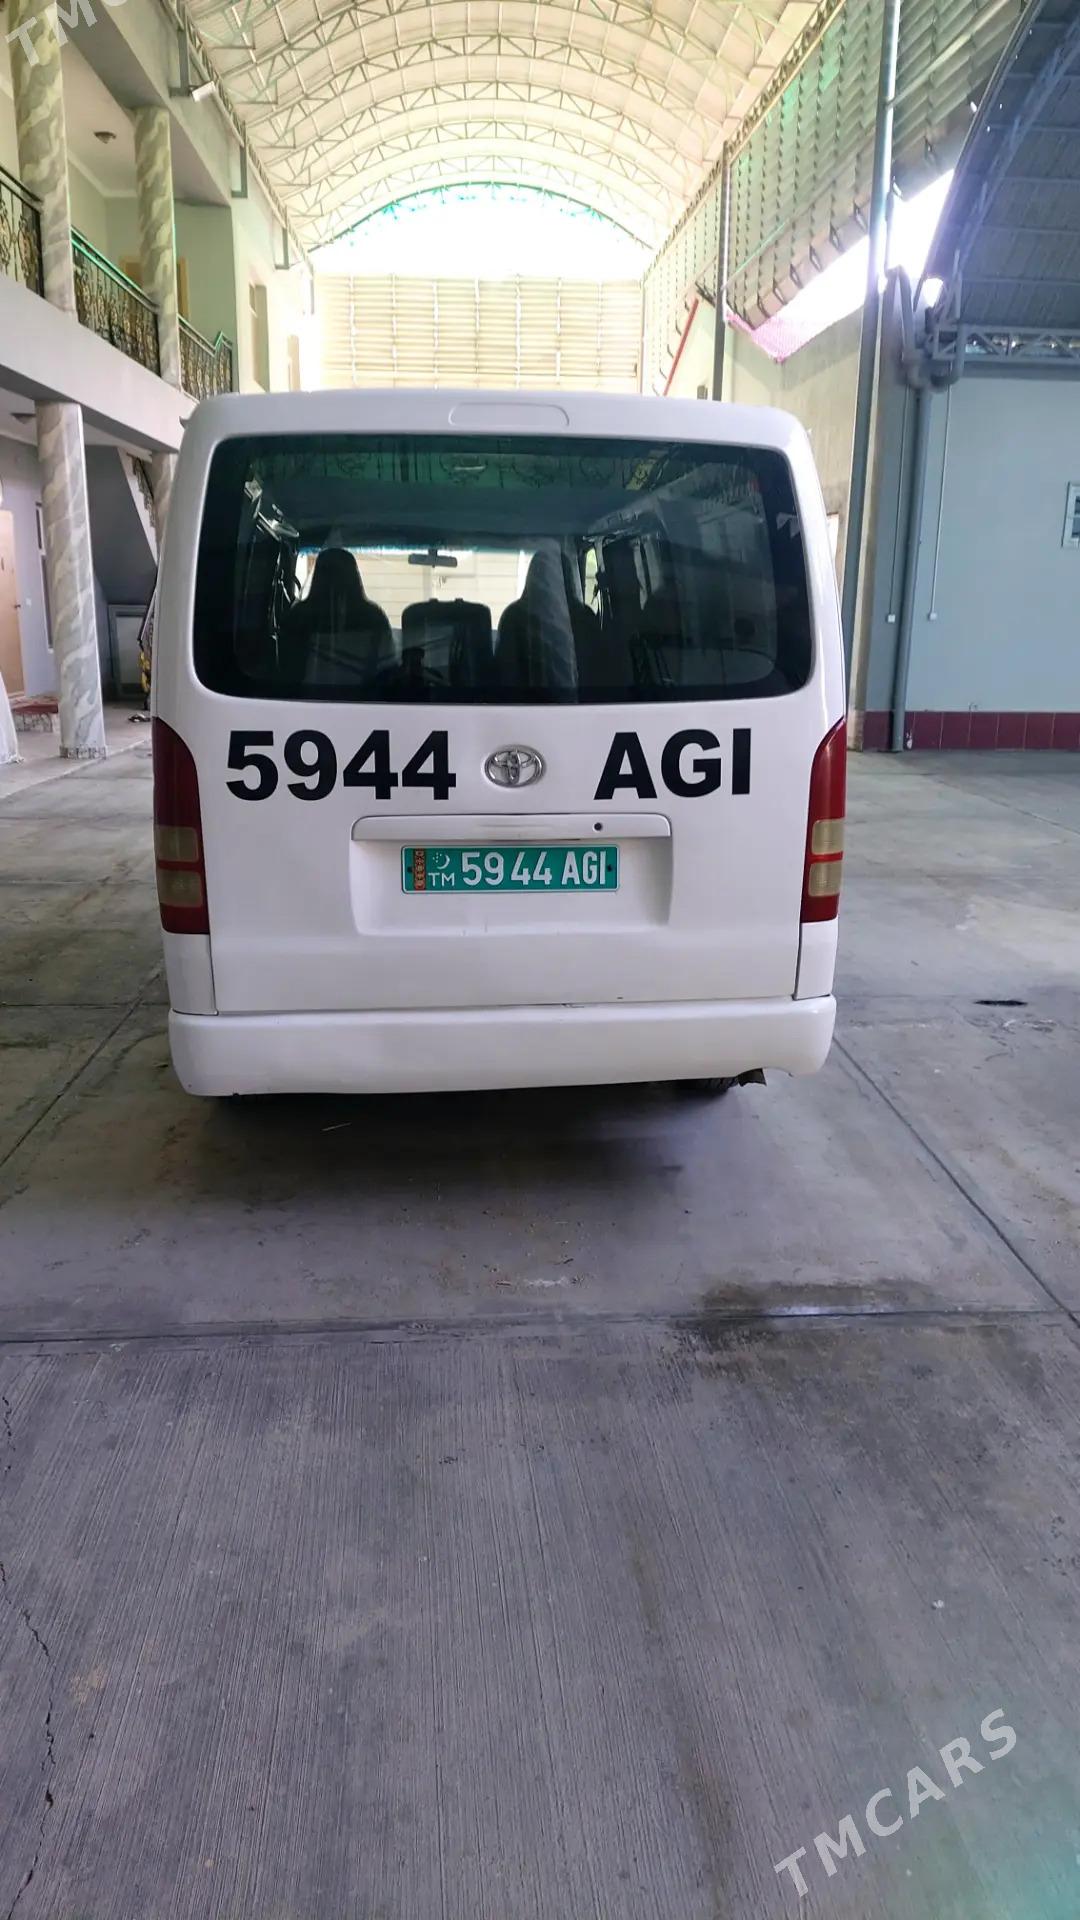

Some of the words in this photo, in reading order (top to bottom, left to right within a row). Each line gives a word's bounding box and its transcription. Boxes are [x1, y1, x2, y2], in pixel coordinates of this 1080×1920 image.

[226, 730, 457, 801] 5944
[594, 727, 752, 800] AGI
[428, 872, 455, 887] TM
[561, 851, 606, 885] AGI
